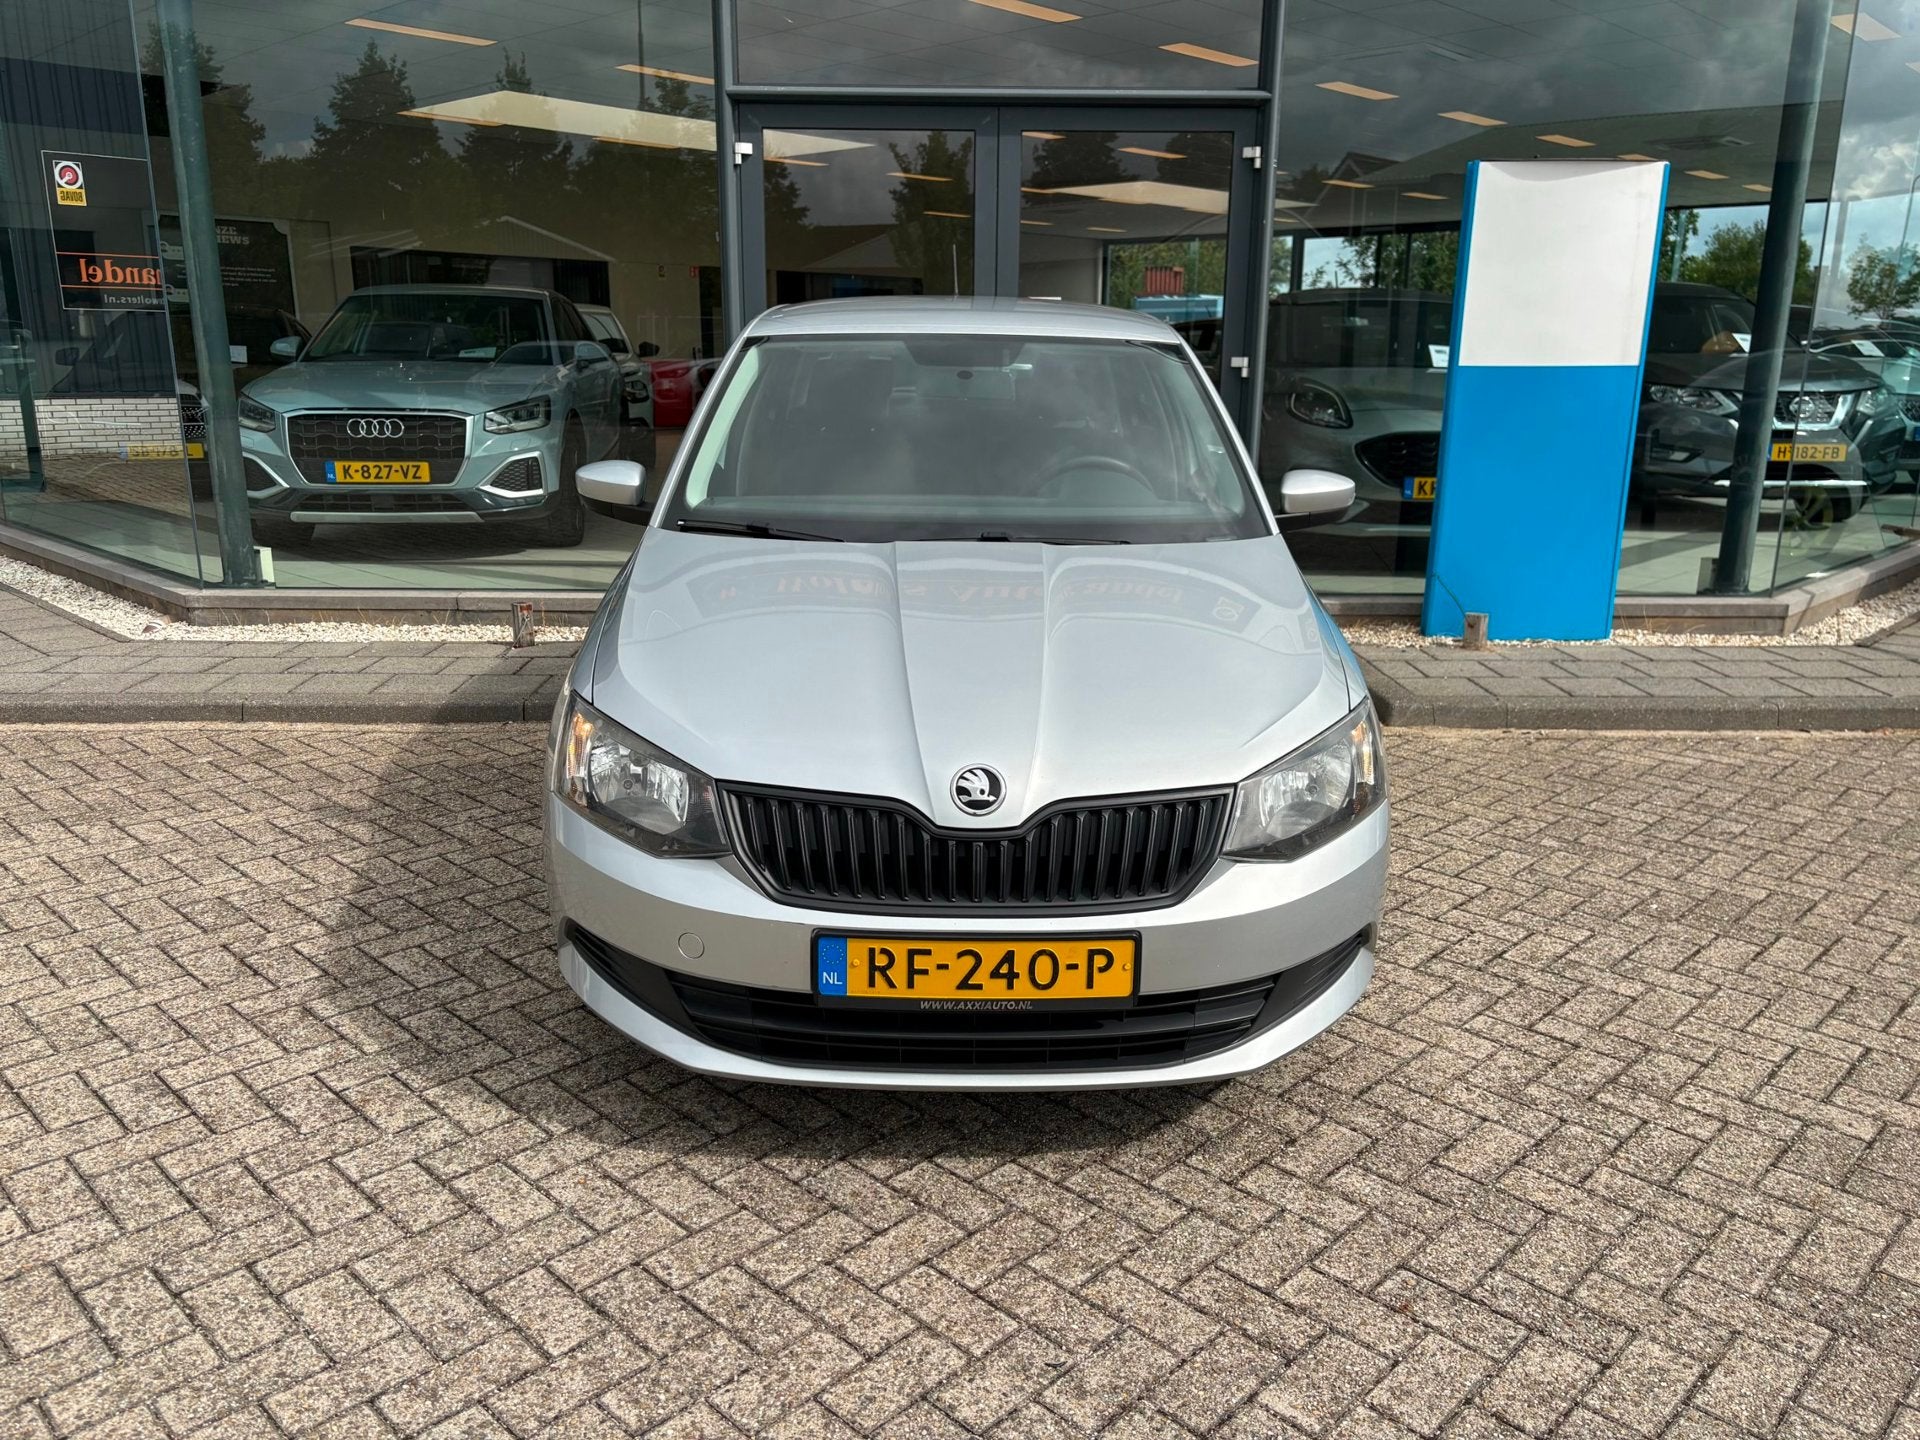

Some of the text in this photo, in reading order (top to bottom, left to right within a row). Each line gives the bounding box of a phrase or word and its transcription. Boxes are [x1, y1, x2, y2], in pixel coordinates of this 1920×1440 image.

[342, 464, 423, 480] K-827-VZ
[867, 947, 1115, 991] RF-240-P
[822, 971, 843, 985] NL
[920, 1000, 1033, 1011] WWW.AXXIAUTO.NL
